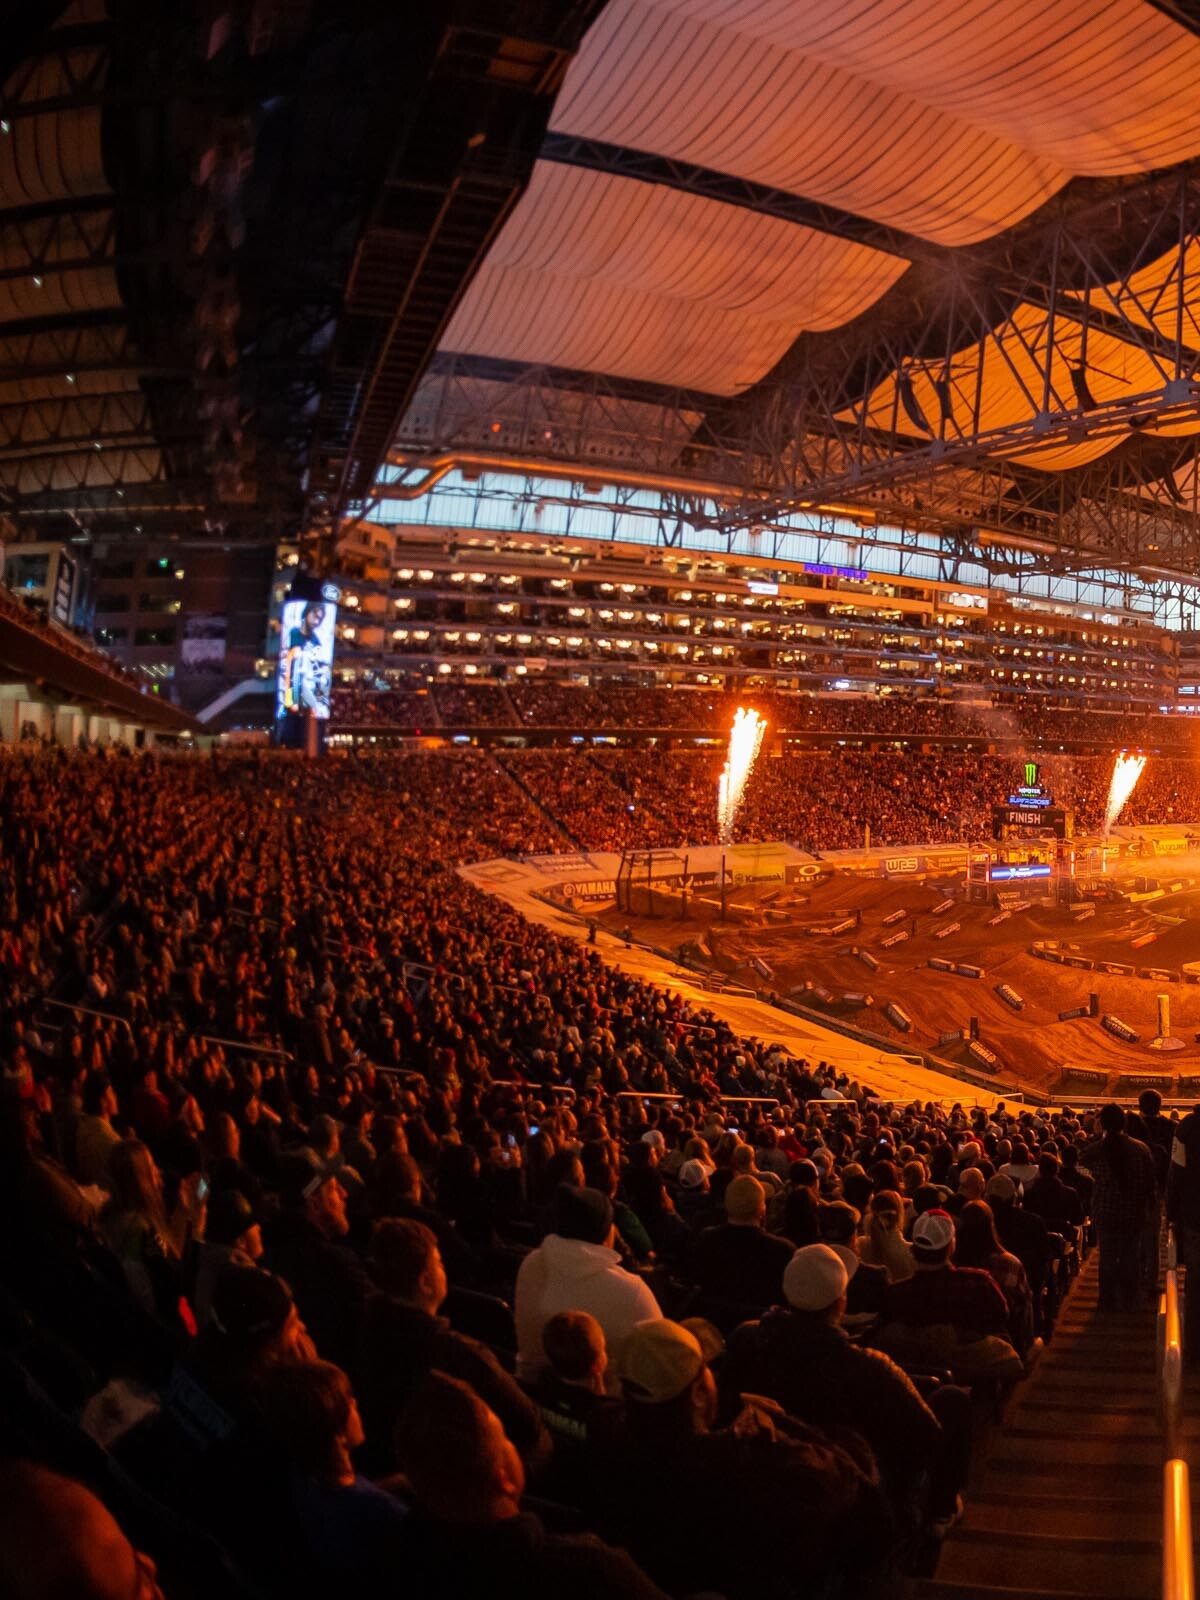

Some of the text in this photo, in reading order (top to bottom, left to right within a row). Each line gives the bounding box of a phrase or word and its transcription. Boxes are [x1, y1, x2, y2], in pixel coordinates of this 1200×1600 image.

[804, 563, 834, 575] FORD
[1009, 812, 1041, 824] FINISH
[575, 881, 616, 896] YAMAHA
